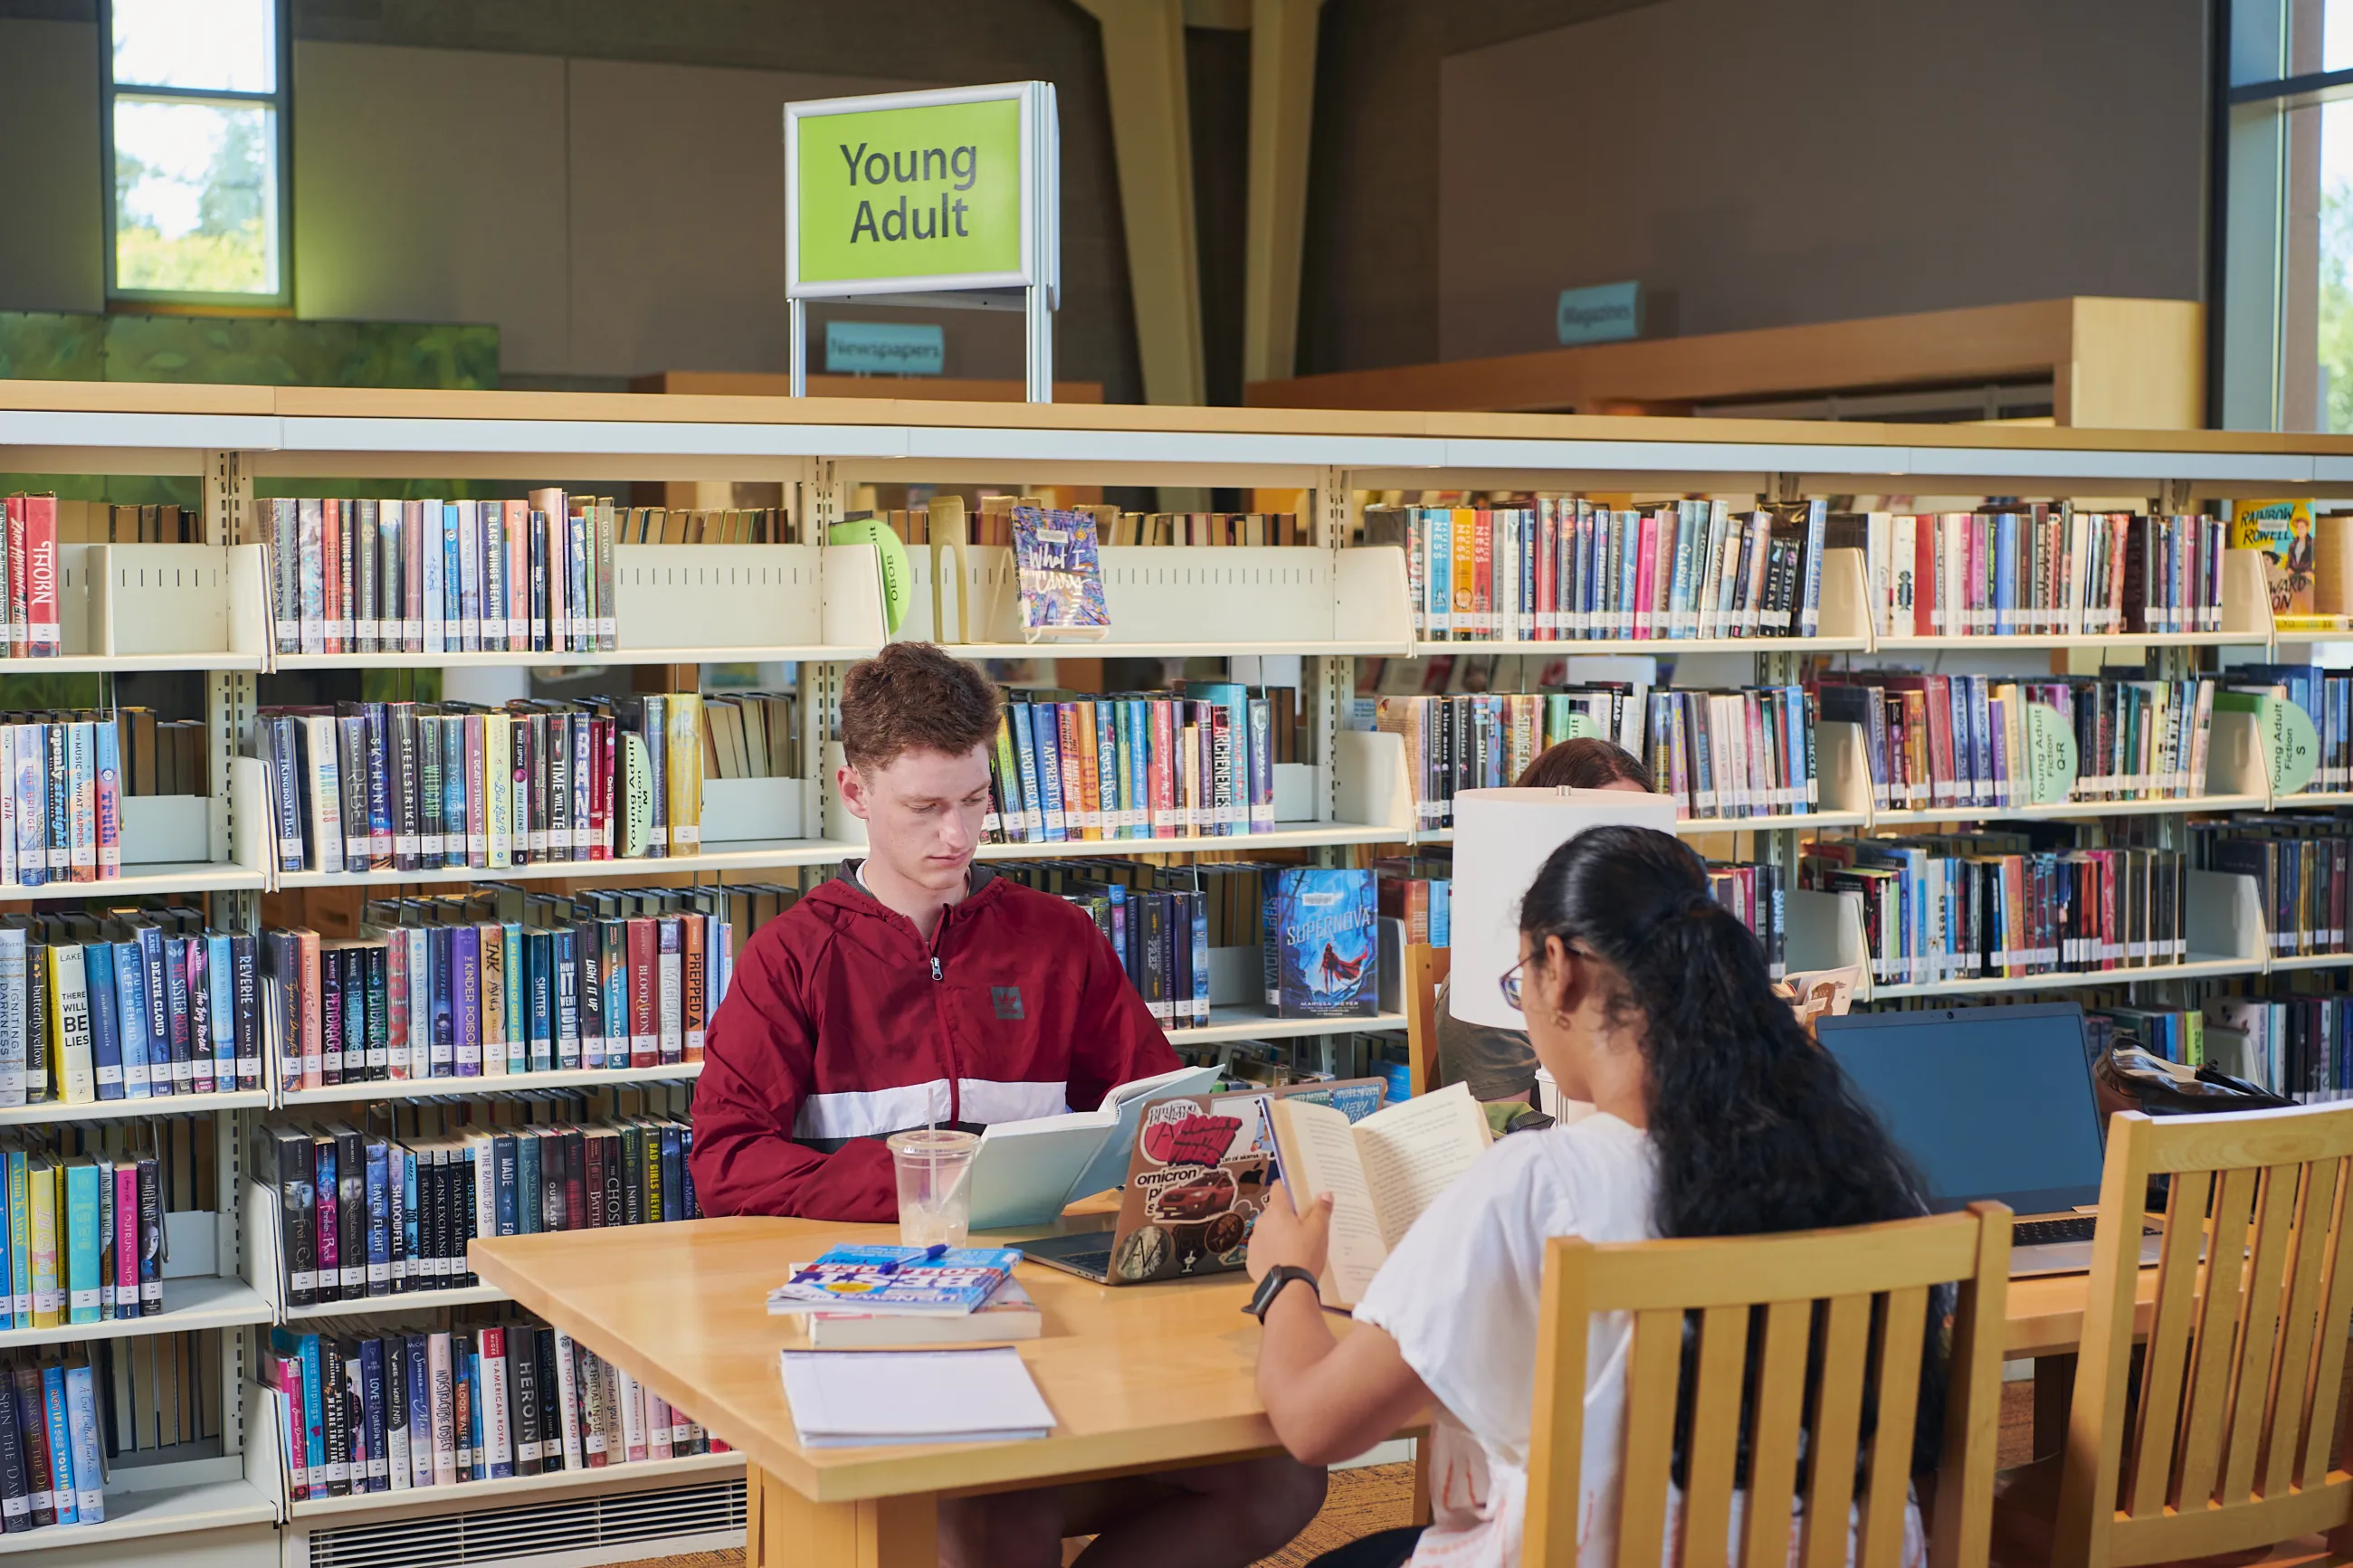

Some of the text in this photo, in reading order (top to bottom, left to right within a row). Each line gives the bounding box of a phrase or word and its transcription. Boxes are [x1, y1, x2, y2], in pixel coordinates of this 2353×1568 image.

[839, 142, 976, 191] Young
[849, 193, 969, 243] Adult
[488, 517, 499, 579] BLACK WINGS
[1433, 521, 1442, 559] NESS
[1456, 525, 1465, 562] NESS
[1475, 526, 1484, 563] NESS
[32, 540, 52, 606] THORN
[887, 555, 898, 601] OBOB
[1061, 714, 1072, 752] MENDEZ
[1517, 715, 1530, 755] STRANGE
[2034, 709, 2045, 799] Young Adult
[2056, 742, 2065, 770] Q-R
[2272, 703, 2283, 791] Young Adult
[2284, 728, 2292, 770] Fiction
[2296, 746, 2305, 755] S
[52, 728, 66, 848] openly straight
[281, 764, 292, 809] KINGDOM
[318, 764, 338, 822] WARCROSS
[370, 738, 385, 836] SKYHUNTER
[403, 738, 414, 836] STEELSTRIKER
[424, 765, 440, 818] WILDCARD
[450, 770, 460, 807] YOUNG
[494, 782, 505, 803] Best
[552, 760, 564, 812] TIME WILL
[1064, 759, 1074, 801] EVERYTHING
[1082, 755, 1098, 813] FURIA
[1215, 727, 1231, 807] ARCHENEMIES
[4, 796, 14, 821] Talk
[26, 765, 35, 832] THE BRIDGE
[101, 790, 116, 843] Truth
[347, 768, 367, 834] REBEL
[643, 790, 648, 805] M
[1287, 906, 1371, 946] SUPERNOVA
[121, 947, 137, 1040] WE LEFT BEHIND
[131, 947, 143, 1013] THE FUTURE
[240, 955, 253, 1004] REVERIE
[464, 963, 474, 1002] KINDER
[485, 942, 501, 1012] INK ASHES
[510, 955, 518, 989] EMOTION
[535, 977, 546, 1017] SHATTER
[586, 959, 598, 1012] LIGHT IT UP
[638, 965, 647, 1003] BLOOD
[690, 953, 701, 1012] PREPPED
[0, 983, 9, 1056] DARKNESS
[11, 988, 20, 1049] IGNITING
[64, 1016, 88, 1032] BE
[150, 961, 164, 1036] DEATH CLOUD
[195, 989, 210, 1051] The Big Reveal
[559, 962, 576, 1039] HOW WENT DOWN
[30, 984, 44, 1066] butterfly yellow
[64, 1037, 89, 1047] LIES
[482, 1171, 491, 1198] RADIUS
[501, 1157, 513, 1186] MADE
[529, 1174, 538, 1211] WICKED
[649, 1143, 660, 1221] BAD GIRLS NEVER
[1138, 1169, 1196, 1184] omicron
[1148, 1185, 1162, 1201] pi
[14, 1164, 26, 1246] Anna Away
[101, 1173, 111, 1239] FINDING VOICE
[142, 1184, 157, 1222] AGENCY
[292, 1218, 311, 1239] Froi
[345, 1201, 359, 1240] Quintana
[373, 1183, 384, 1253] RAVEN FLIGHT
[391, 1184, 403, 1255] SHADOWFELL
[405, 1208, 417, 1223] ZOO
[319, 1204, 335, 1261] Finnikin Rock
[309, 1340, 320, 1421] second helpings
[413, 1352, 426, 1387] SUMMER
[494, 1368, 503, 1415] AMERICAN
[23, 1386, 44, 1470] UNRAVEL THE
[51, 1389, 67, 1471] NOT YOU
[369, 1377, 381, 1439] LOVE FOREIGN
[435, 1369, 452, 1453] INDESTRUCTIBLE OBJECT
[4, 1431, 15, 1459] THE
[81, 1396, 95, 1473] Girl Called Fearless
